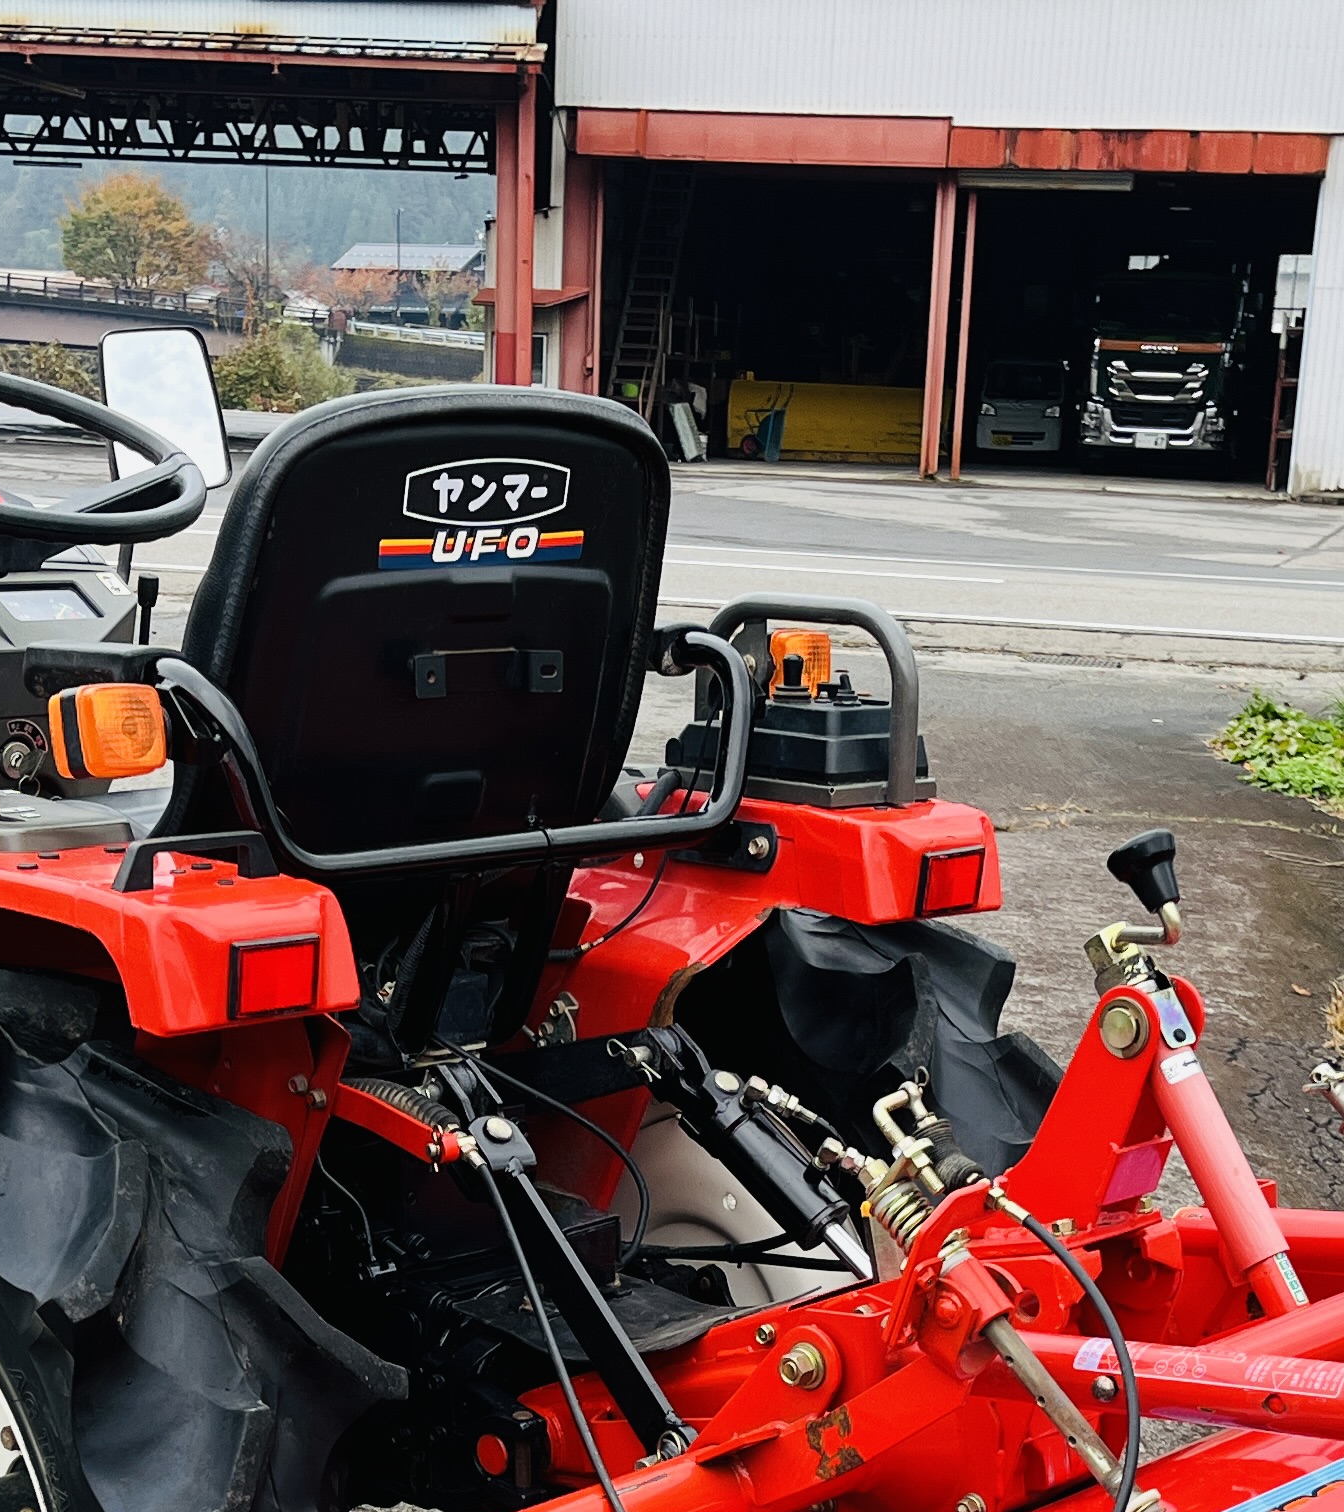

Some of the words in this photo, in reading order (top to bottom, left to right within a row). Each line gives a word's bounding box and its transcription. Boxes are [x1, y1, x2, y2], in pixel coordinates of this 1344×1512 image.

[432, 472, 549, 514] ヤンマー
[430, 525, 540, 564] UFO
